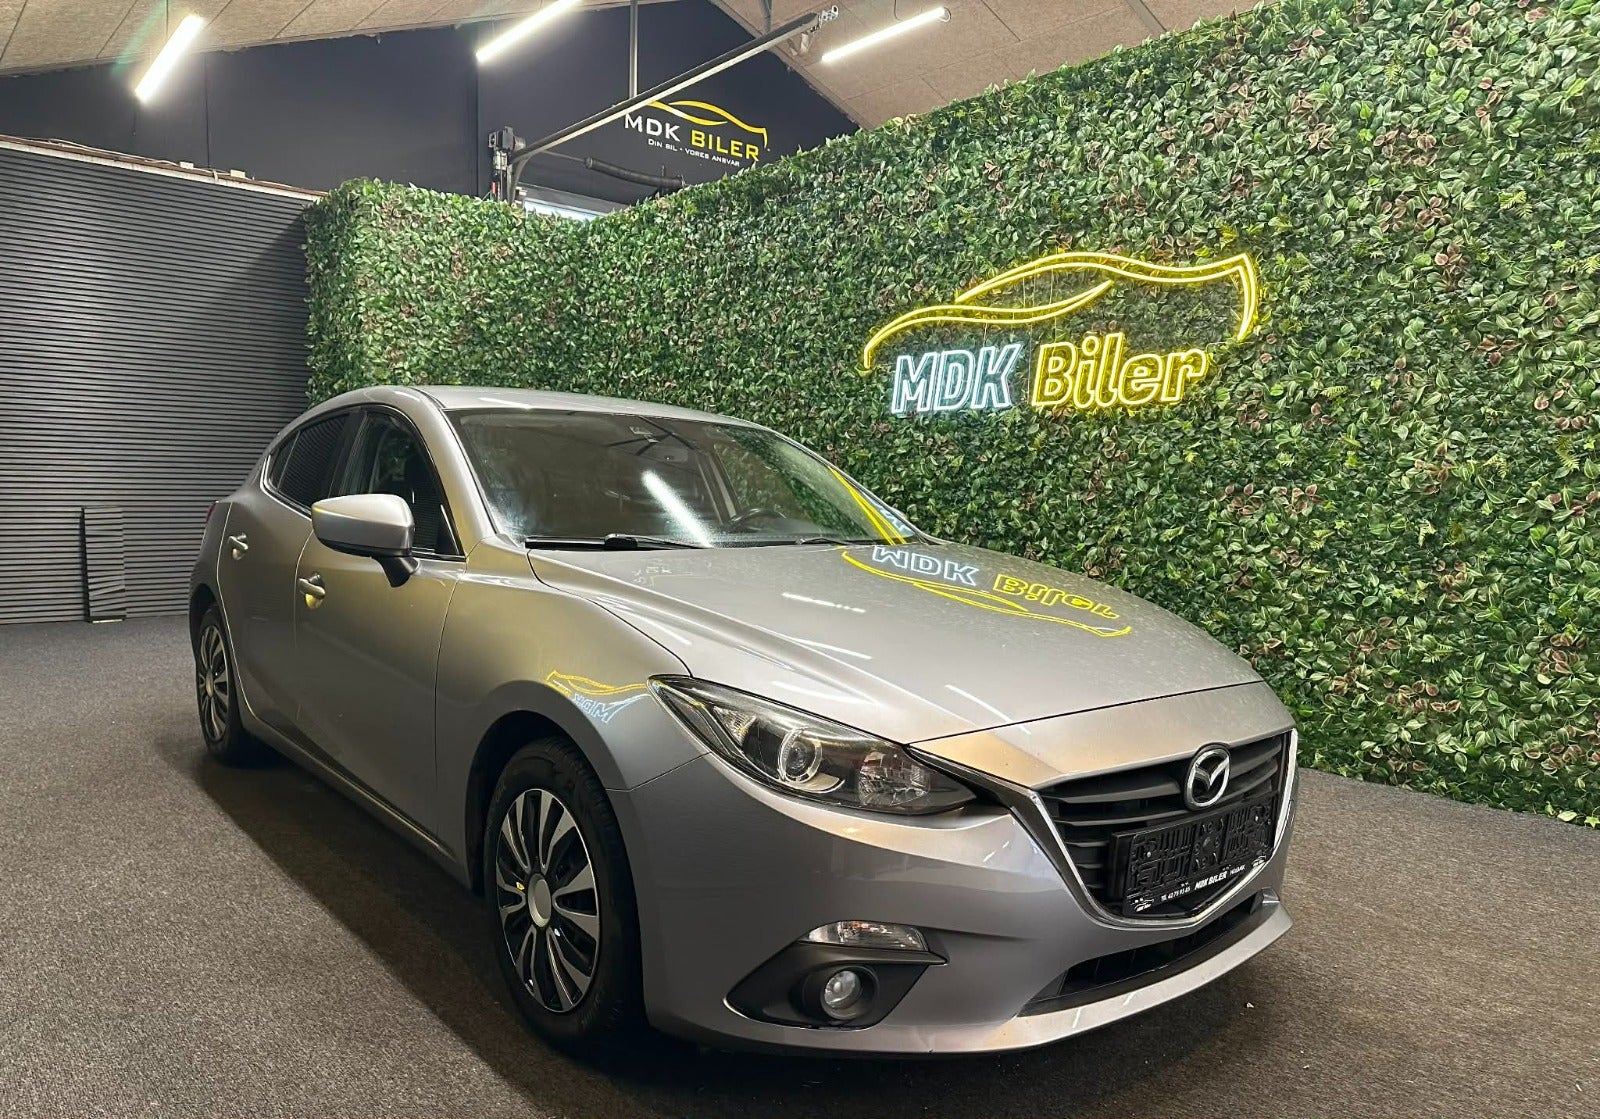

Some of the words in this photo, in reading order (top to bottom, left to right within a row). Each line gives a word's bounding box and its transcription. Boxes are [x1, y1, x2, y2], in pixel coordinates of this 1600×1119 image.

[624, 113, 680, 142] MDK
[691, 129, 760, 162] BILER
[665, 143, 678, 152] BIL
[685, 148, 710, 160] VORES
[711, 155, 740, 167] ANSVAR
[891, 343, 1023, 414] MDK
[1031, 332, 1208, 409] Biler
